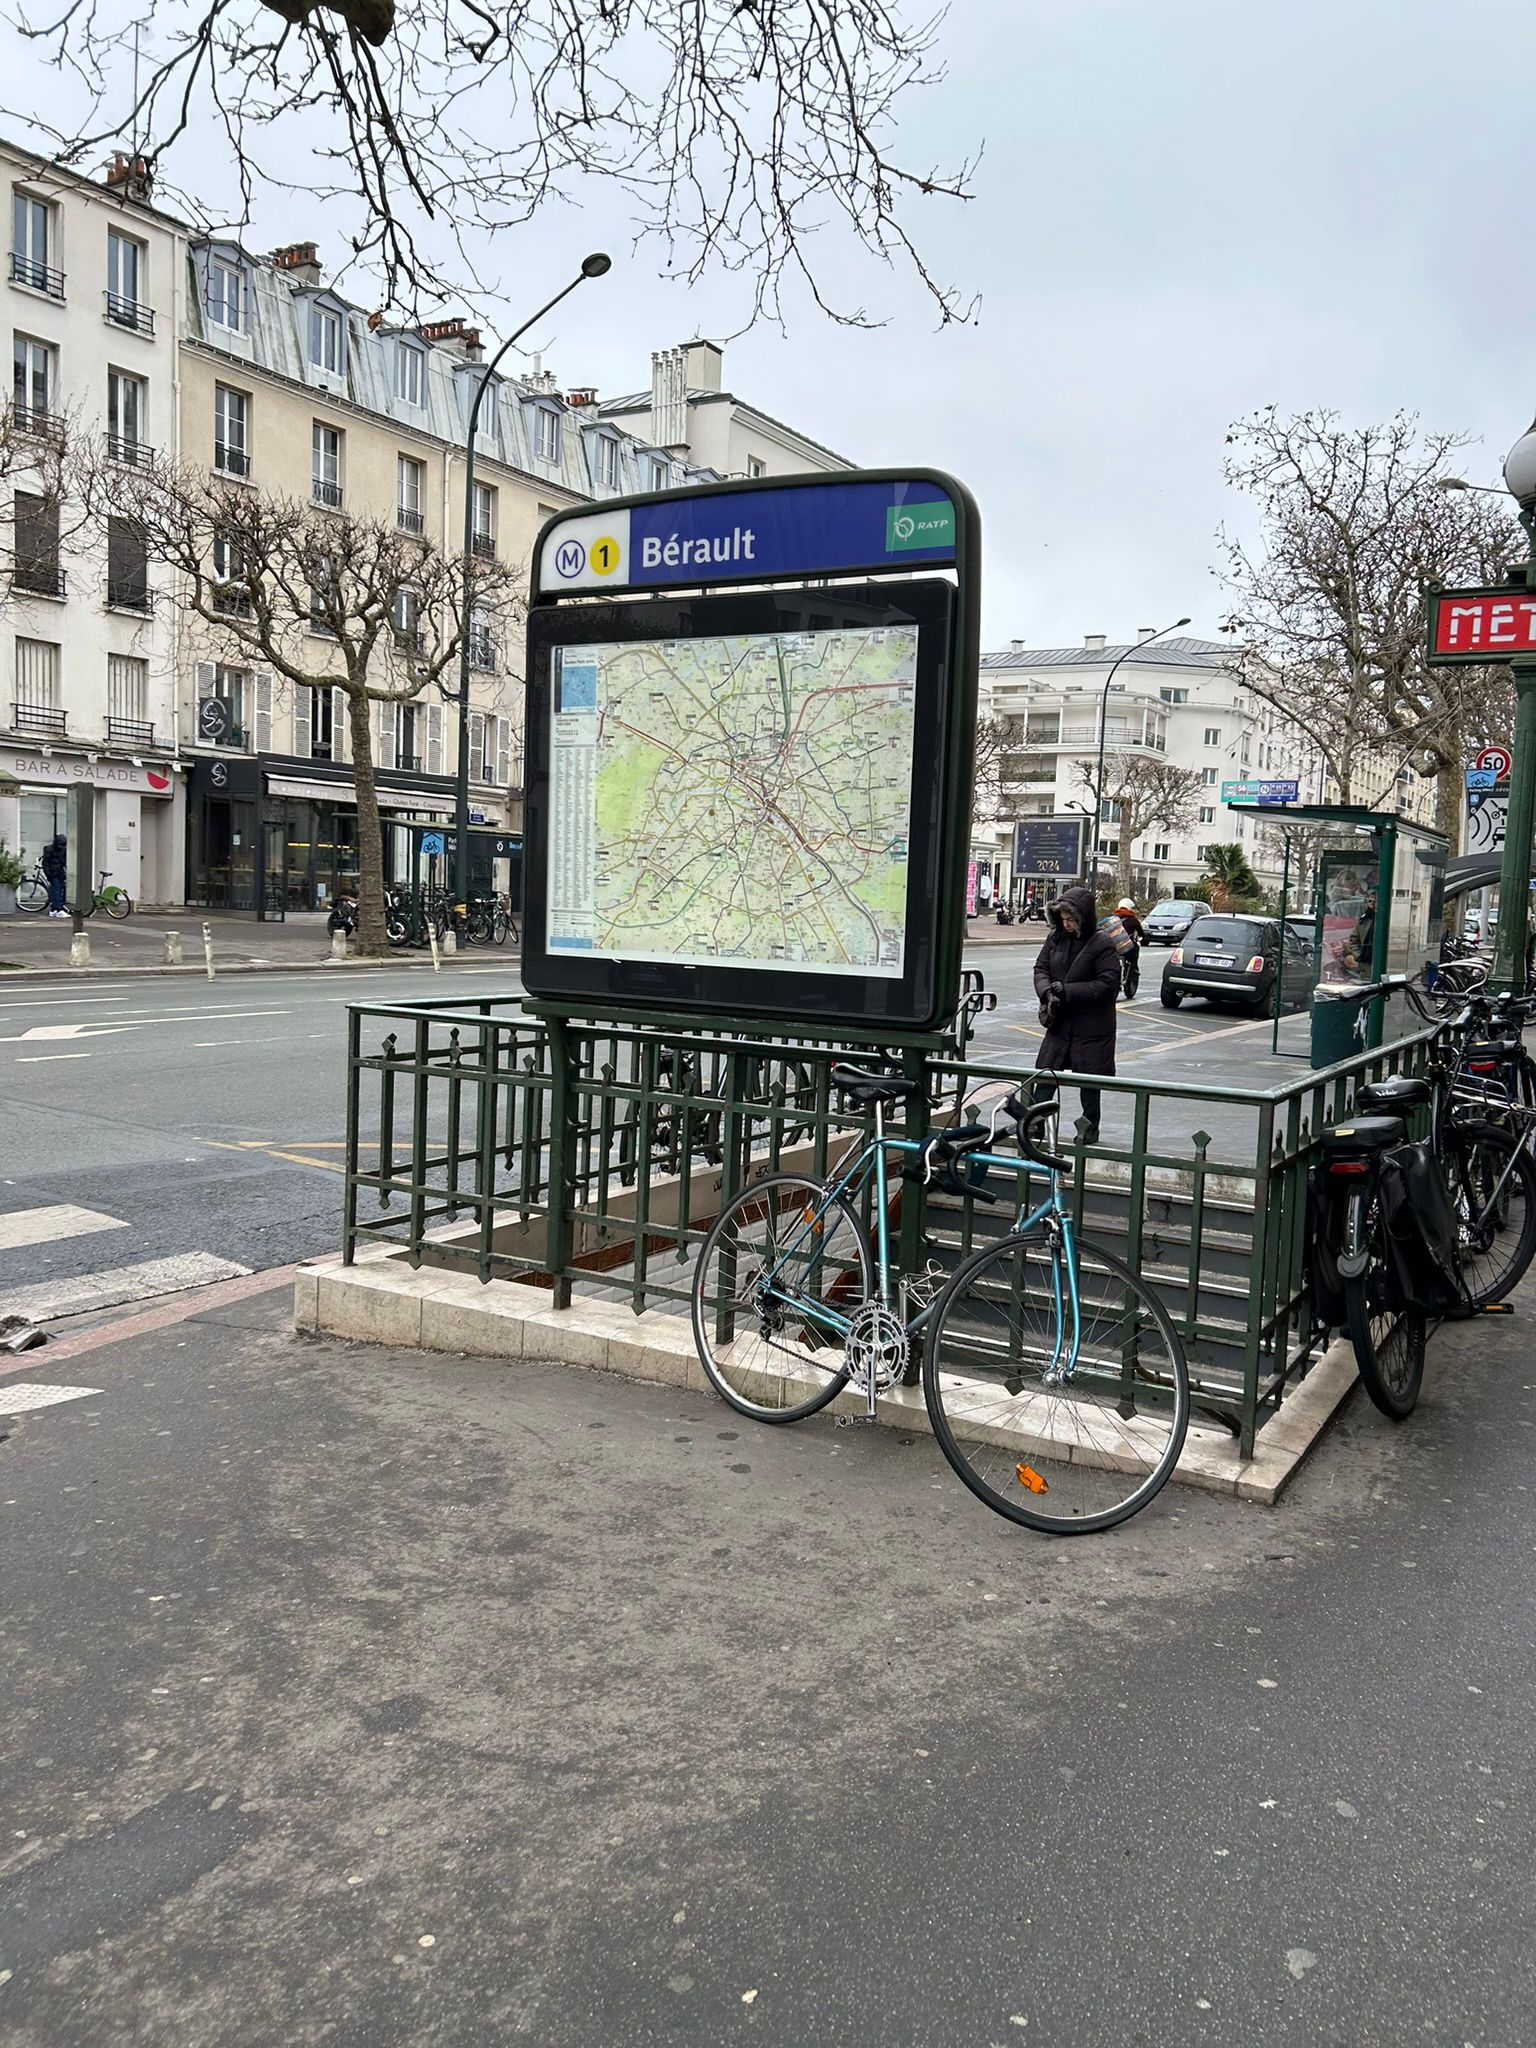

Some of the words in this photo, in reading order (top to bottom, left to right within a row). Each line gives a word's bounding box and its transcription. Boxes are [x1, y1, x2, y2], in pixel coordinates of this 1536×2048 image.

[917, 520, 949, 530] RATP
[598, 544, 609, 568] 1
[642, 527, 755, 568] Bérault
[15, 758, 50, 774] BAR
[57, 760, 67, 776] À
[73, 764, 139, 782] SALADE
[1483, 757, 1504, 770] 50
[1036, 860, 1060, 872] 2024
